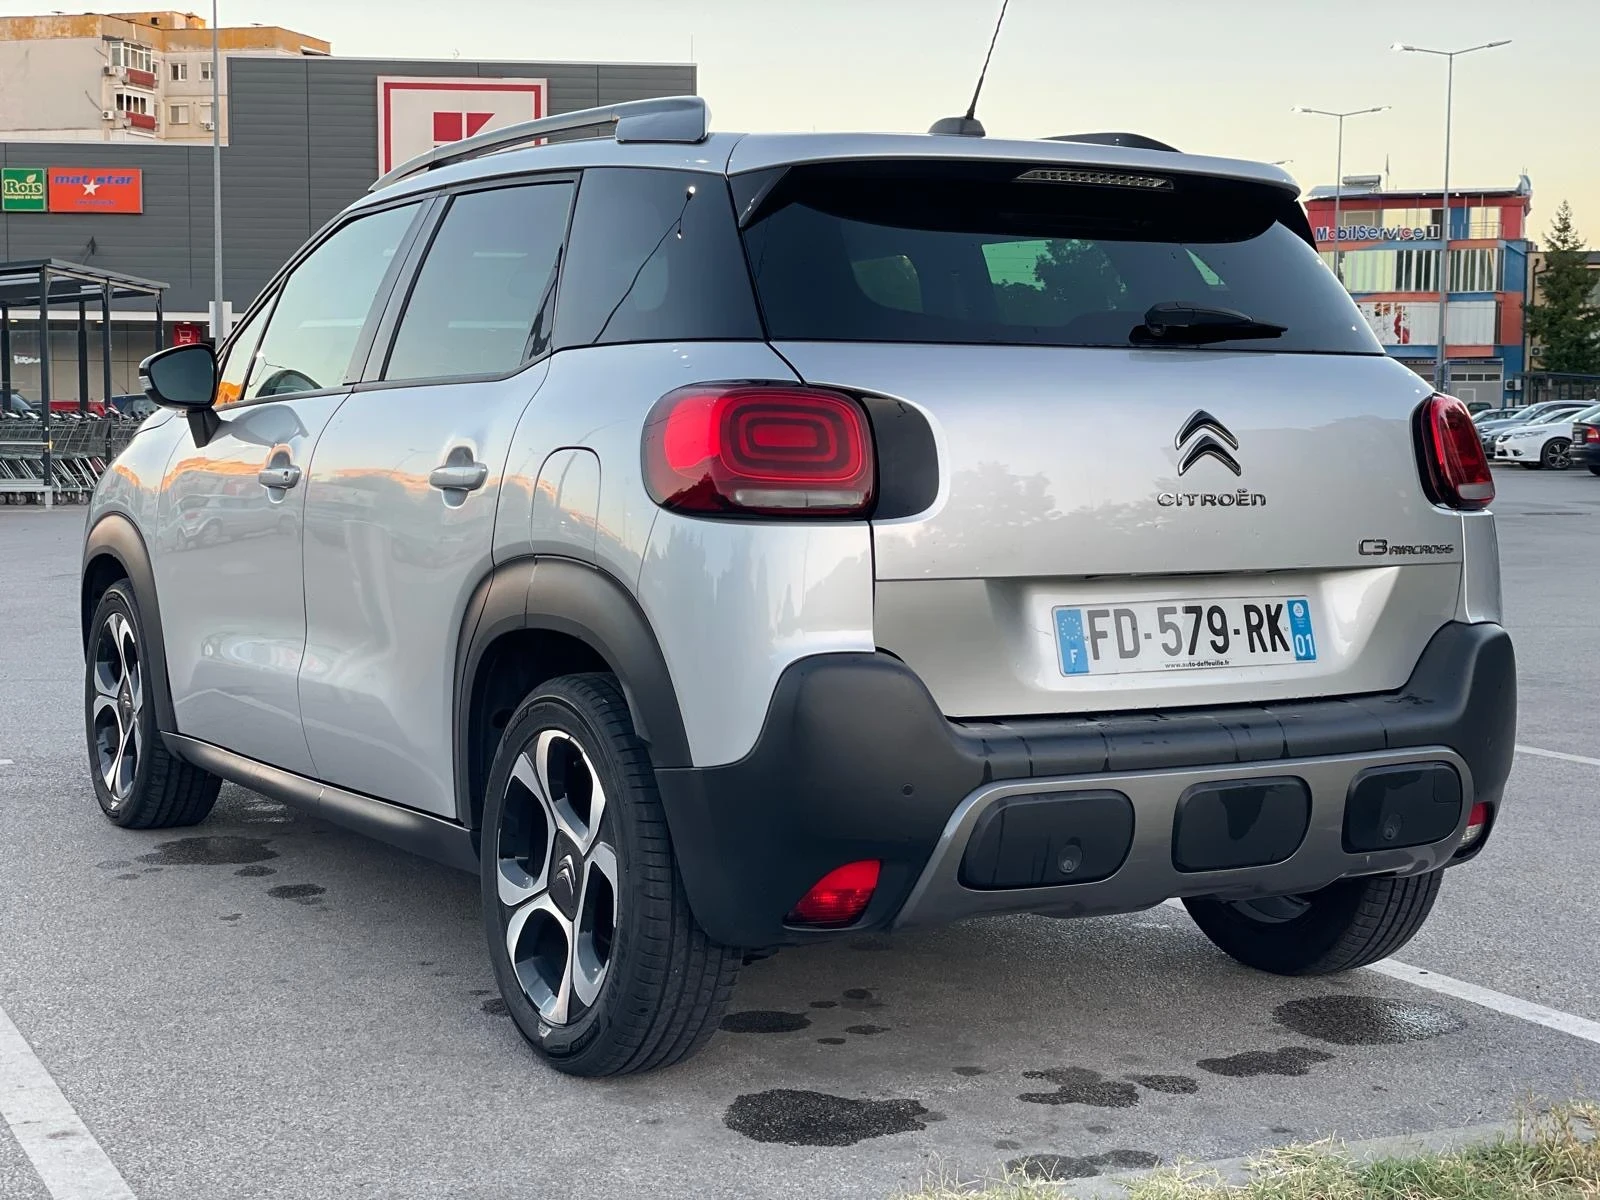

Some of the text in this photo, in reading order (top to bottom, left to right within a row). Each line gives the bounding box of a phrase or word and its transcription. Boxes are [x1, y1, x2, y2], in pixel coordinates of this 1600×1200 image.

[4, 179, 43, 195] Rois
[1358, 539, 1454, 556] C3 AIRCROSS
[1087, 603, 1290, 661] FD-579-RK
[1294, 633, 1315, 657] 01
[1070, 649, 1078, 664] F
